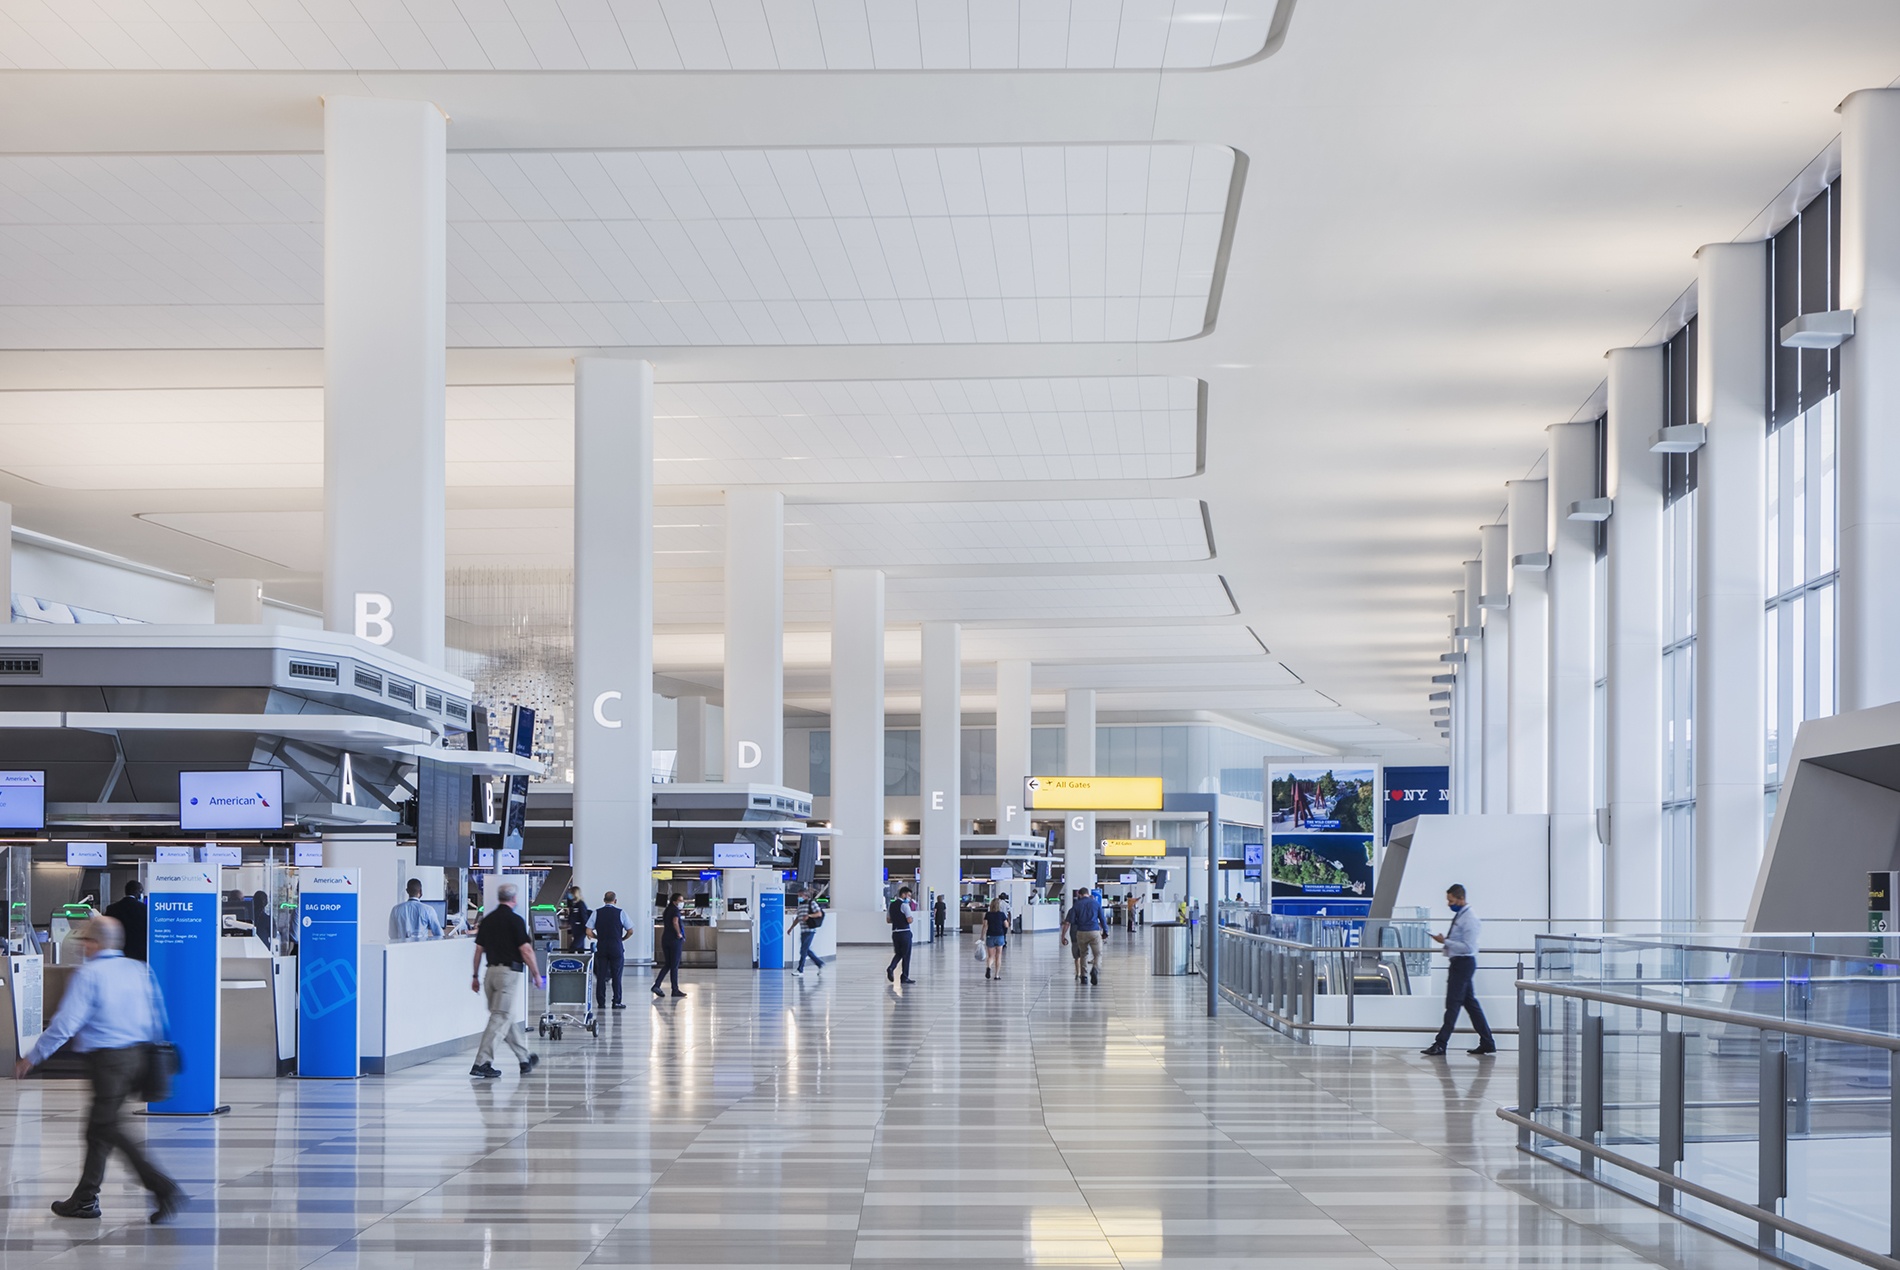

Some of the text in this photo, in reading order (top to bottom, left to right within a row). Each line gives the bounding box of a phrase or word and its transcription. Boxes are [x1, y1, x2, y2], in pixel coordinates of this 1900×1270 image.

[354, 592, 394, 646] B
[593, 690, 622, 728] C
[738, 740, 762, 769] D
[341, 752, 356, 805] A
[209, 796, 256, 806] American
[485, 782, 494, 824] B
[932, 791, 944, 810] E
[1404, 790, 1428, 801] NY
[1006, 806, 1017, 822] F
[1071, 816, 1084, 831] G
[1136, 825, 1147, 838] H
[154, 902, 194, 911] SHUTTLE
